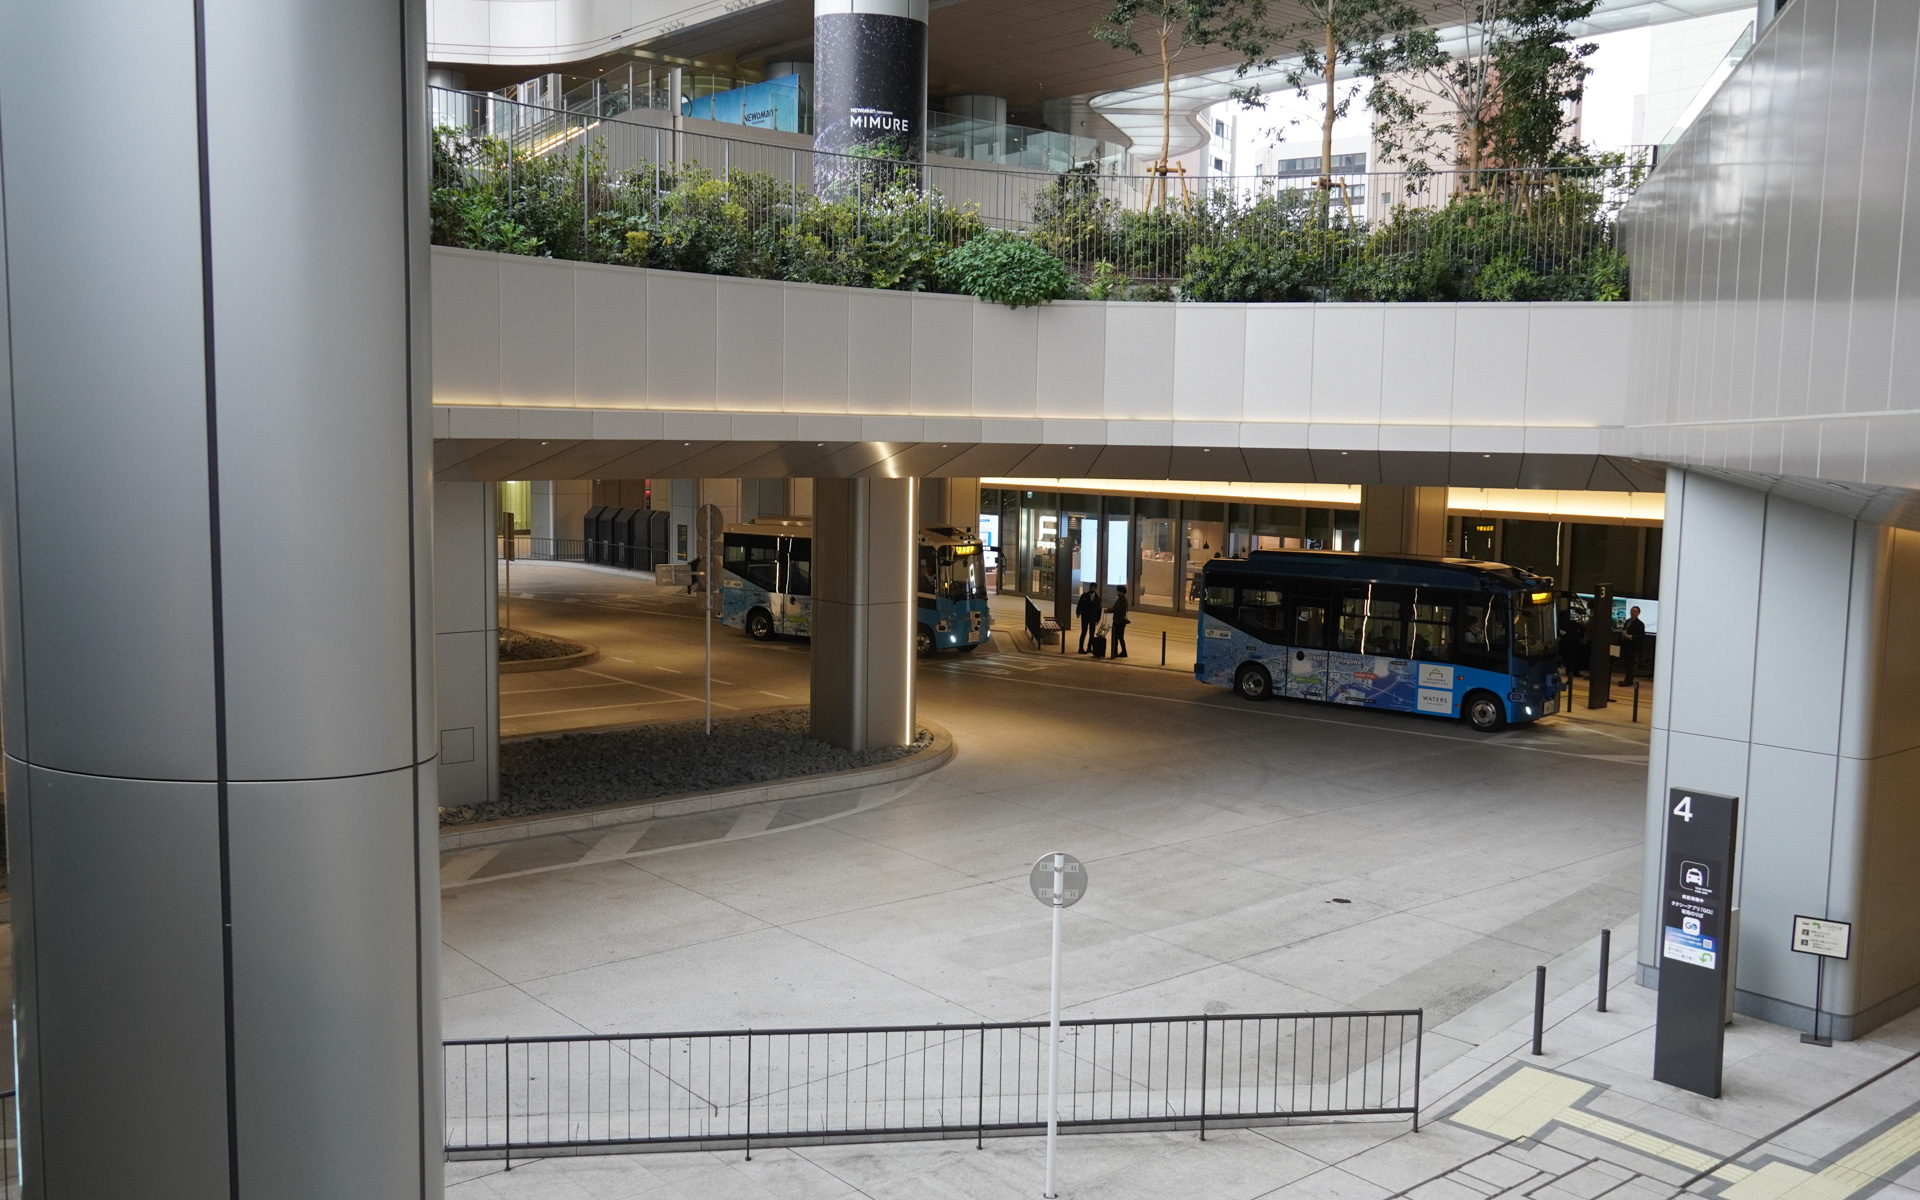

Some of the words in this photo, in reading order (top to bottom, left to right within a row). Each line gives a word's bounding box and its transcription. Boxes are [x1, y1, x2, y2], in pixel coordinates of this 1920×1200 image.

[850, 116, 909, 132] MIMURE
[1060, 539, 1065, 548] 2
[1600, 586, 1606, 598] 3
[1306, 653, 1328, 661] Greater
[1330, 656, 1361, 666] Shinagawa
[1422, 695, 1448, 704] WATERS
[1673, 796, 1693, 822] 4
[1685, 921, 1698, 931] GO
